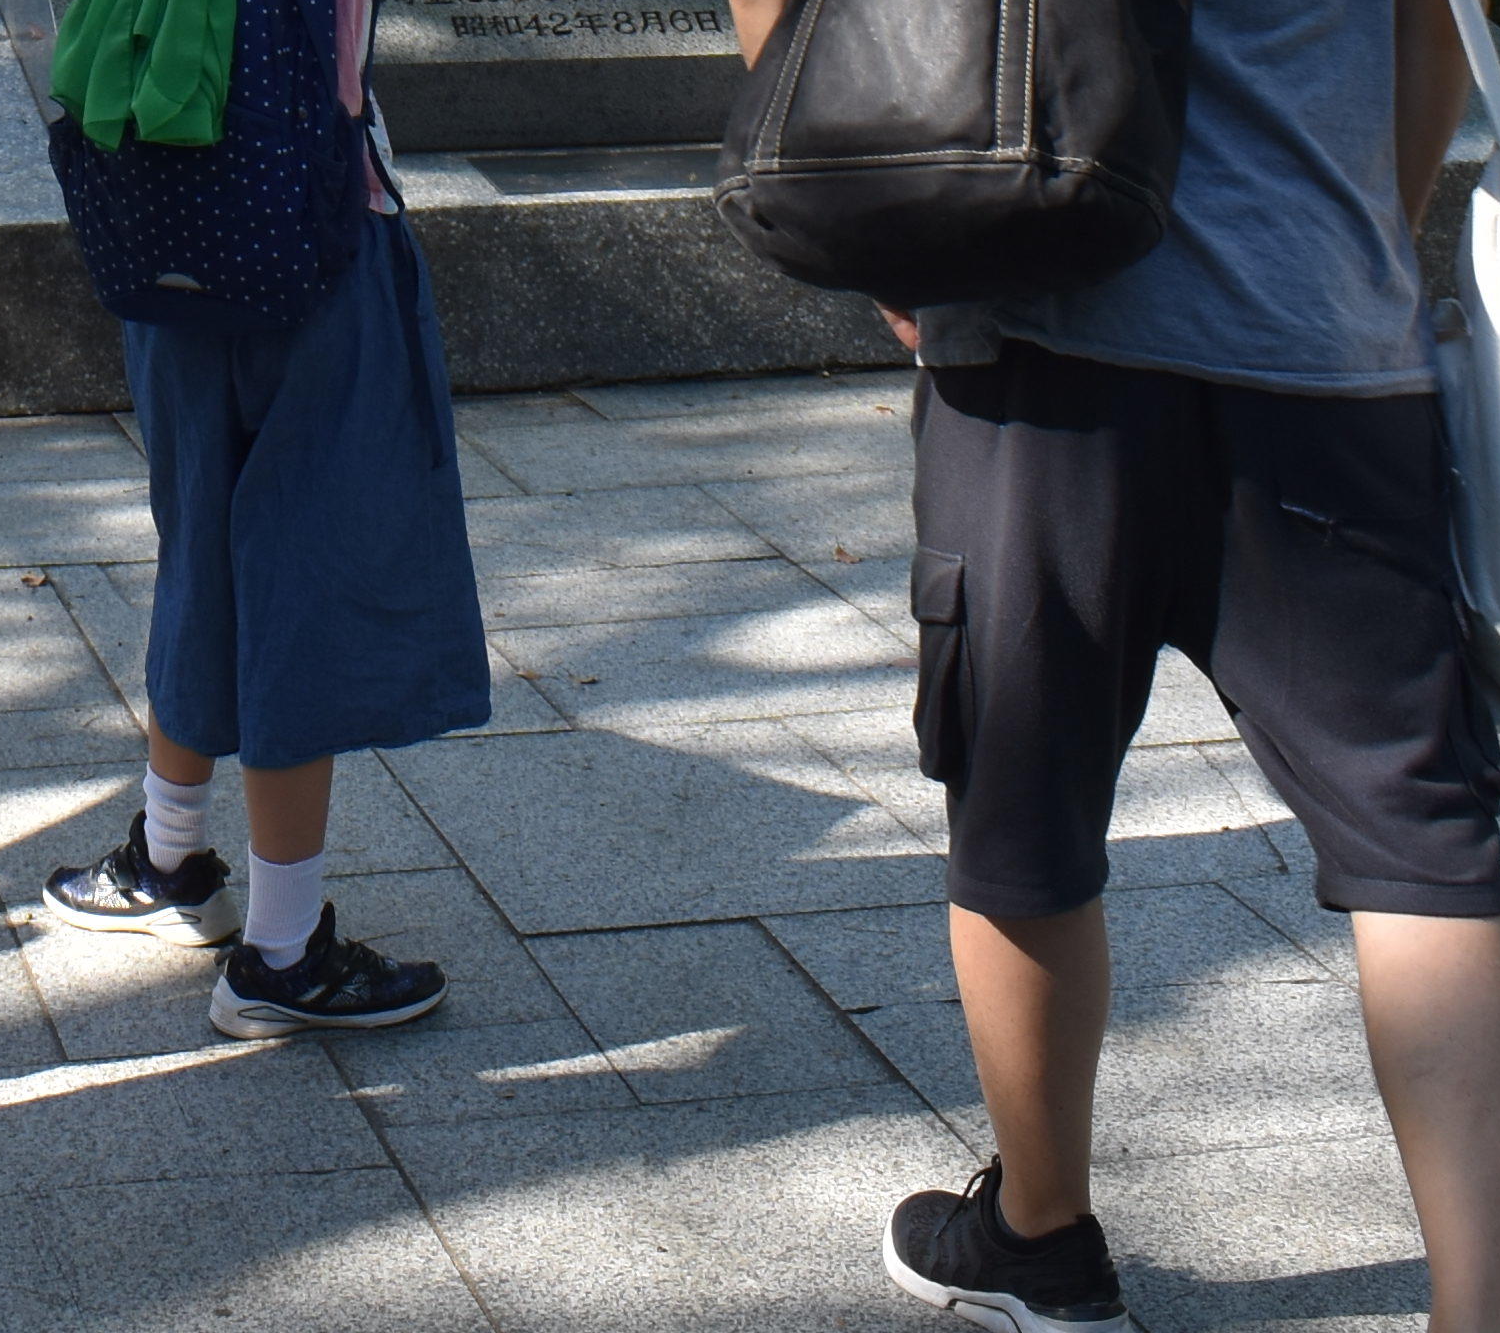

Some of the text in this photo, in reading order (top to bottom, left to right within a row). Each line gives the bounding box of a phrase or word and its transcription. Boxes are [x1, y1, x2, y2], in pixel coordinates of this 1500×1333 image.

[452, 9, 724, 37] 昭和42年8月6日
